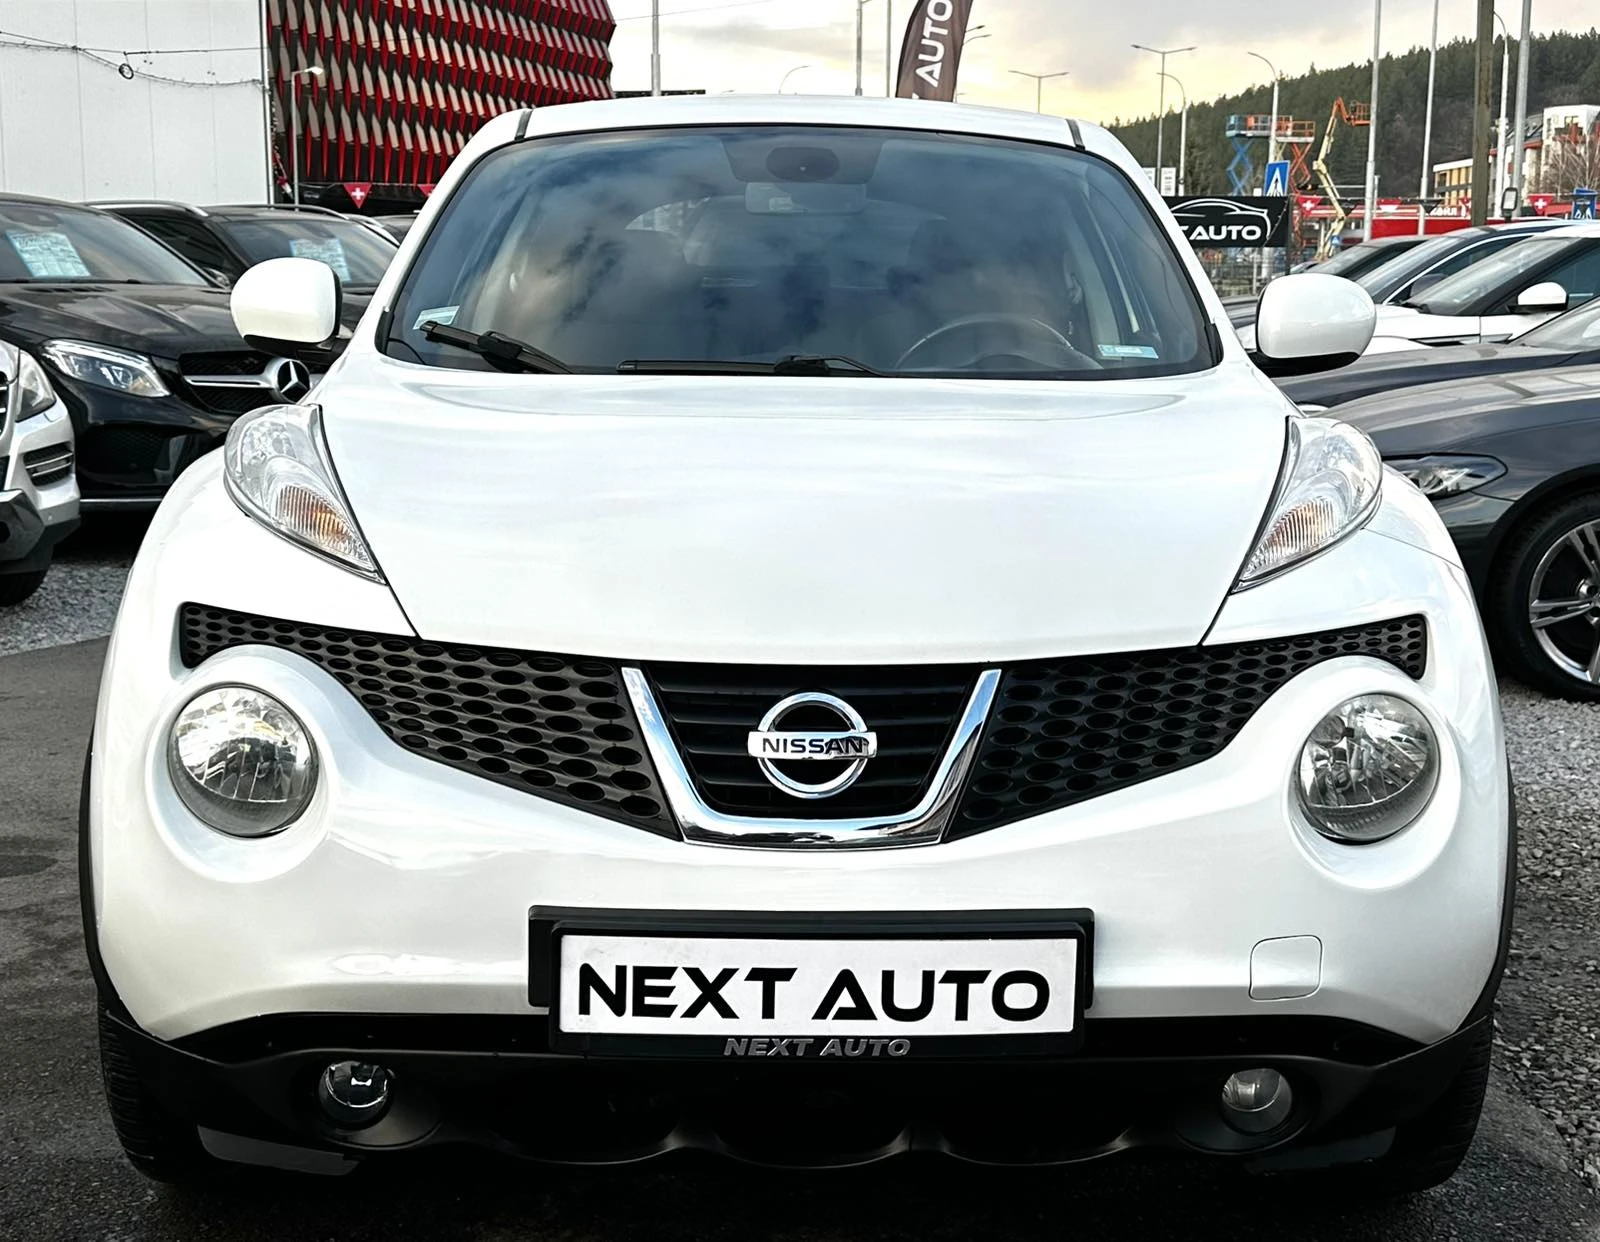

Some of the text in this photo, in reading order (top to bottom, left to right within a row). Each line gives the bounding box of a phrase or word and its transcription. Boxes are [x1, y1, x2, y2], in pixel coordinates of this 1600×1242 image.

[915, 0, 953, 87] AUTO
[1189, 225, 1261, 240] AUTO
[762, 738, 863, 754] NISSAN
[578, 962, 1050, 1023] NEXT AUTO
[723, 1038, 911, 1058] NEXT AUTO
